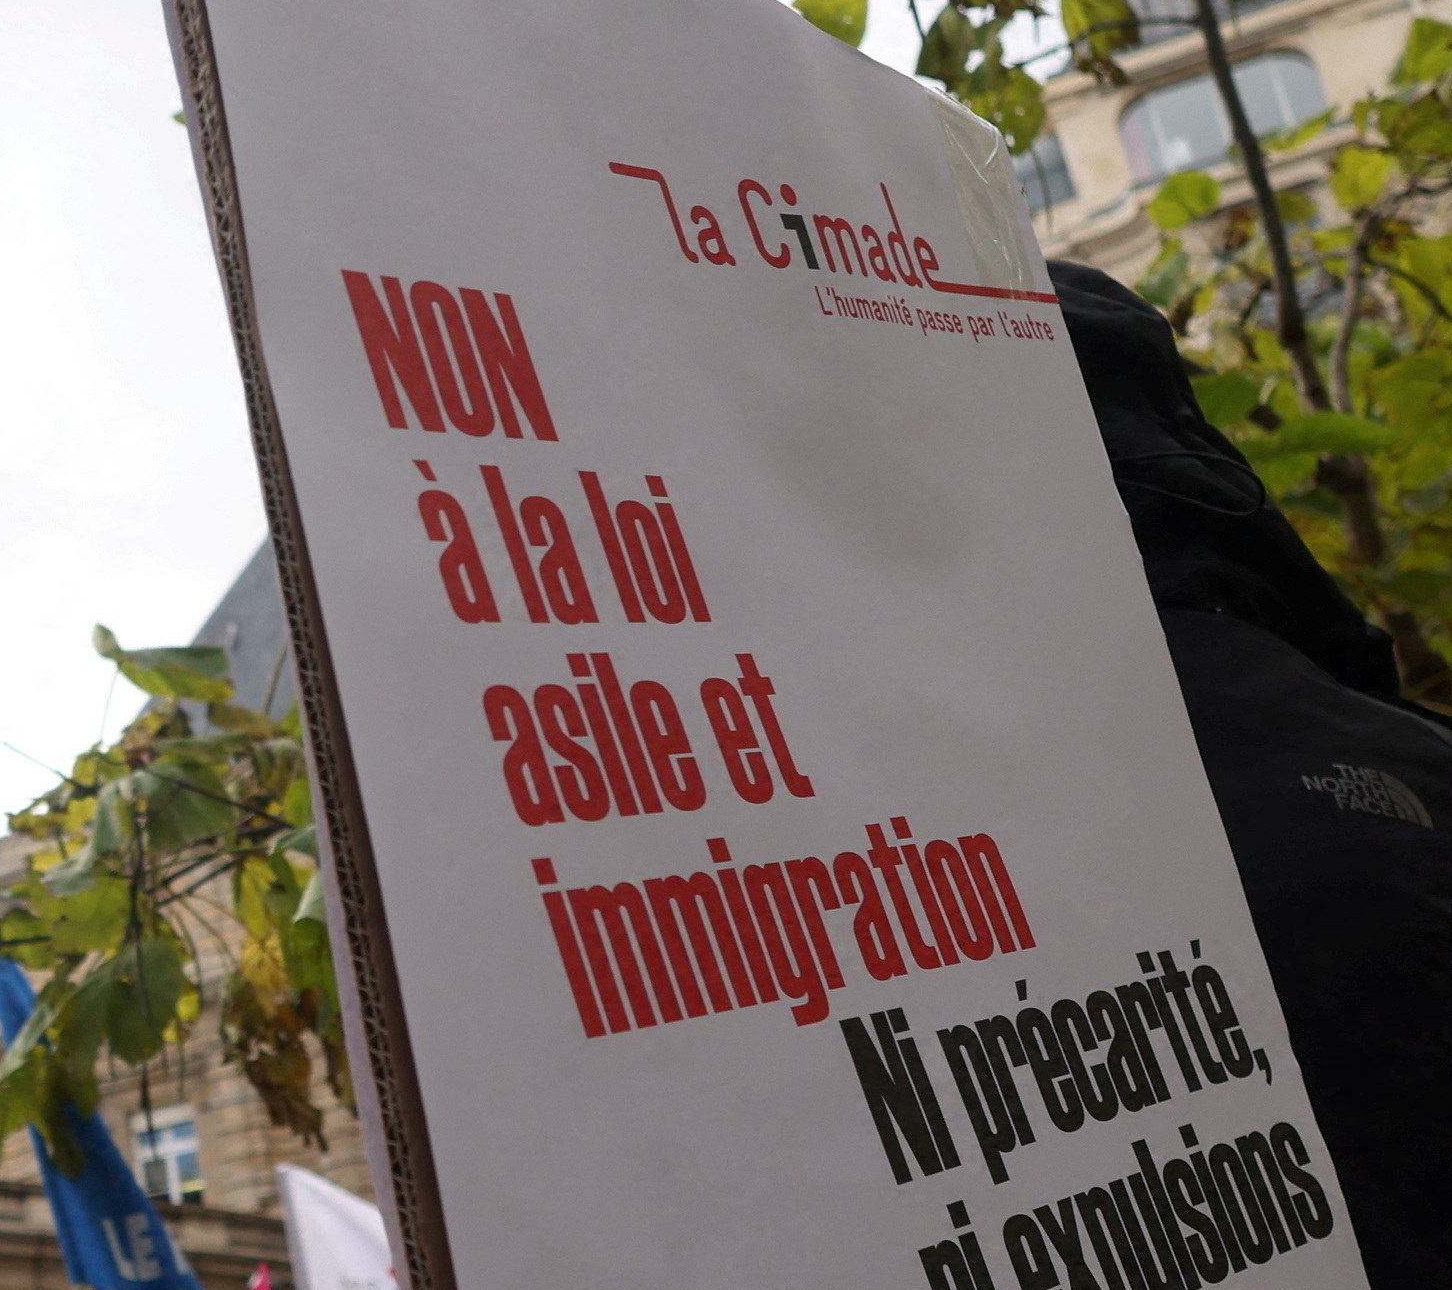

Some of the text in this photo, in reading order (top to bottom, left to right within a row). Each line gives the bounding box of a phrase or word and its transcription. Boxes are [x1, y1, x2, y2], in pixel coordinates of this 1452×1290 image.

[608, 161, 1059, 304] la Cimade
[340, 269, 559, 442] NON
[814, 285, 1055, 343] L'humanité passe par l'autre
[412, 459, 713, 625] à la loi
[482, 652, 816, 827] asile et
[1300, 773, 1392, 803] NORTH
[1331, 762, 1382, 786] THE
[1333, 793, 1397, 820] FACE
[530, 815, 1038, 1039] immigration
[838, 939, 1273, 1186] Ni précarité,
